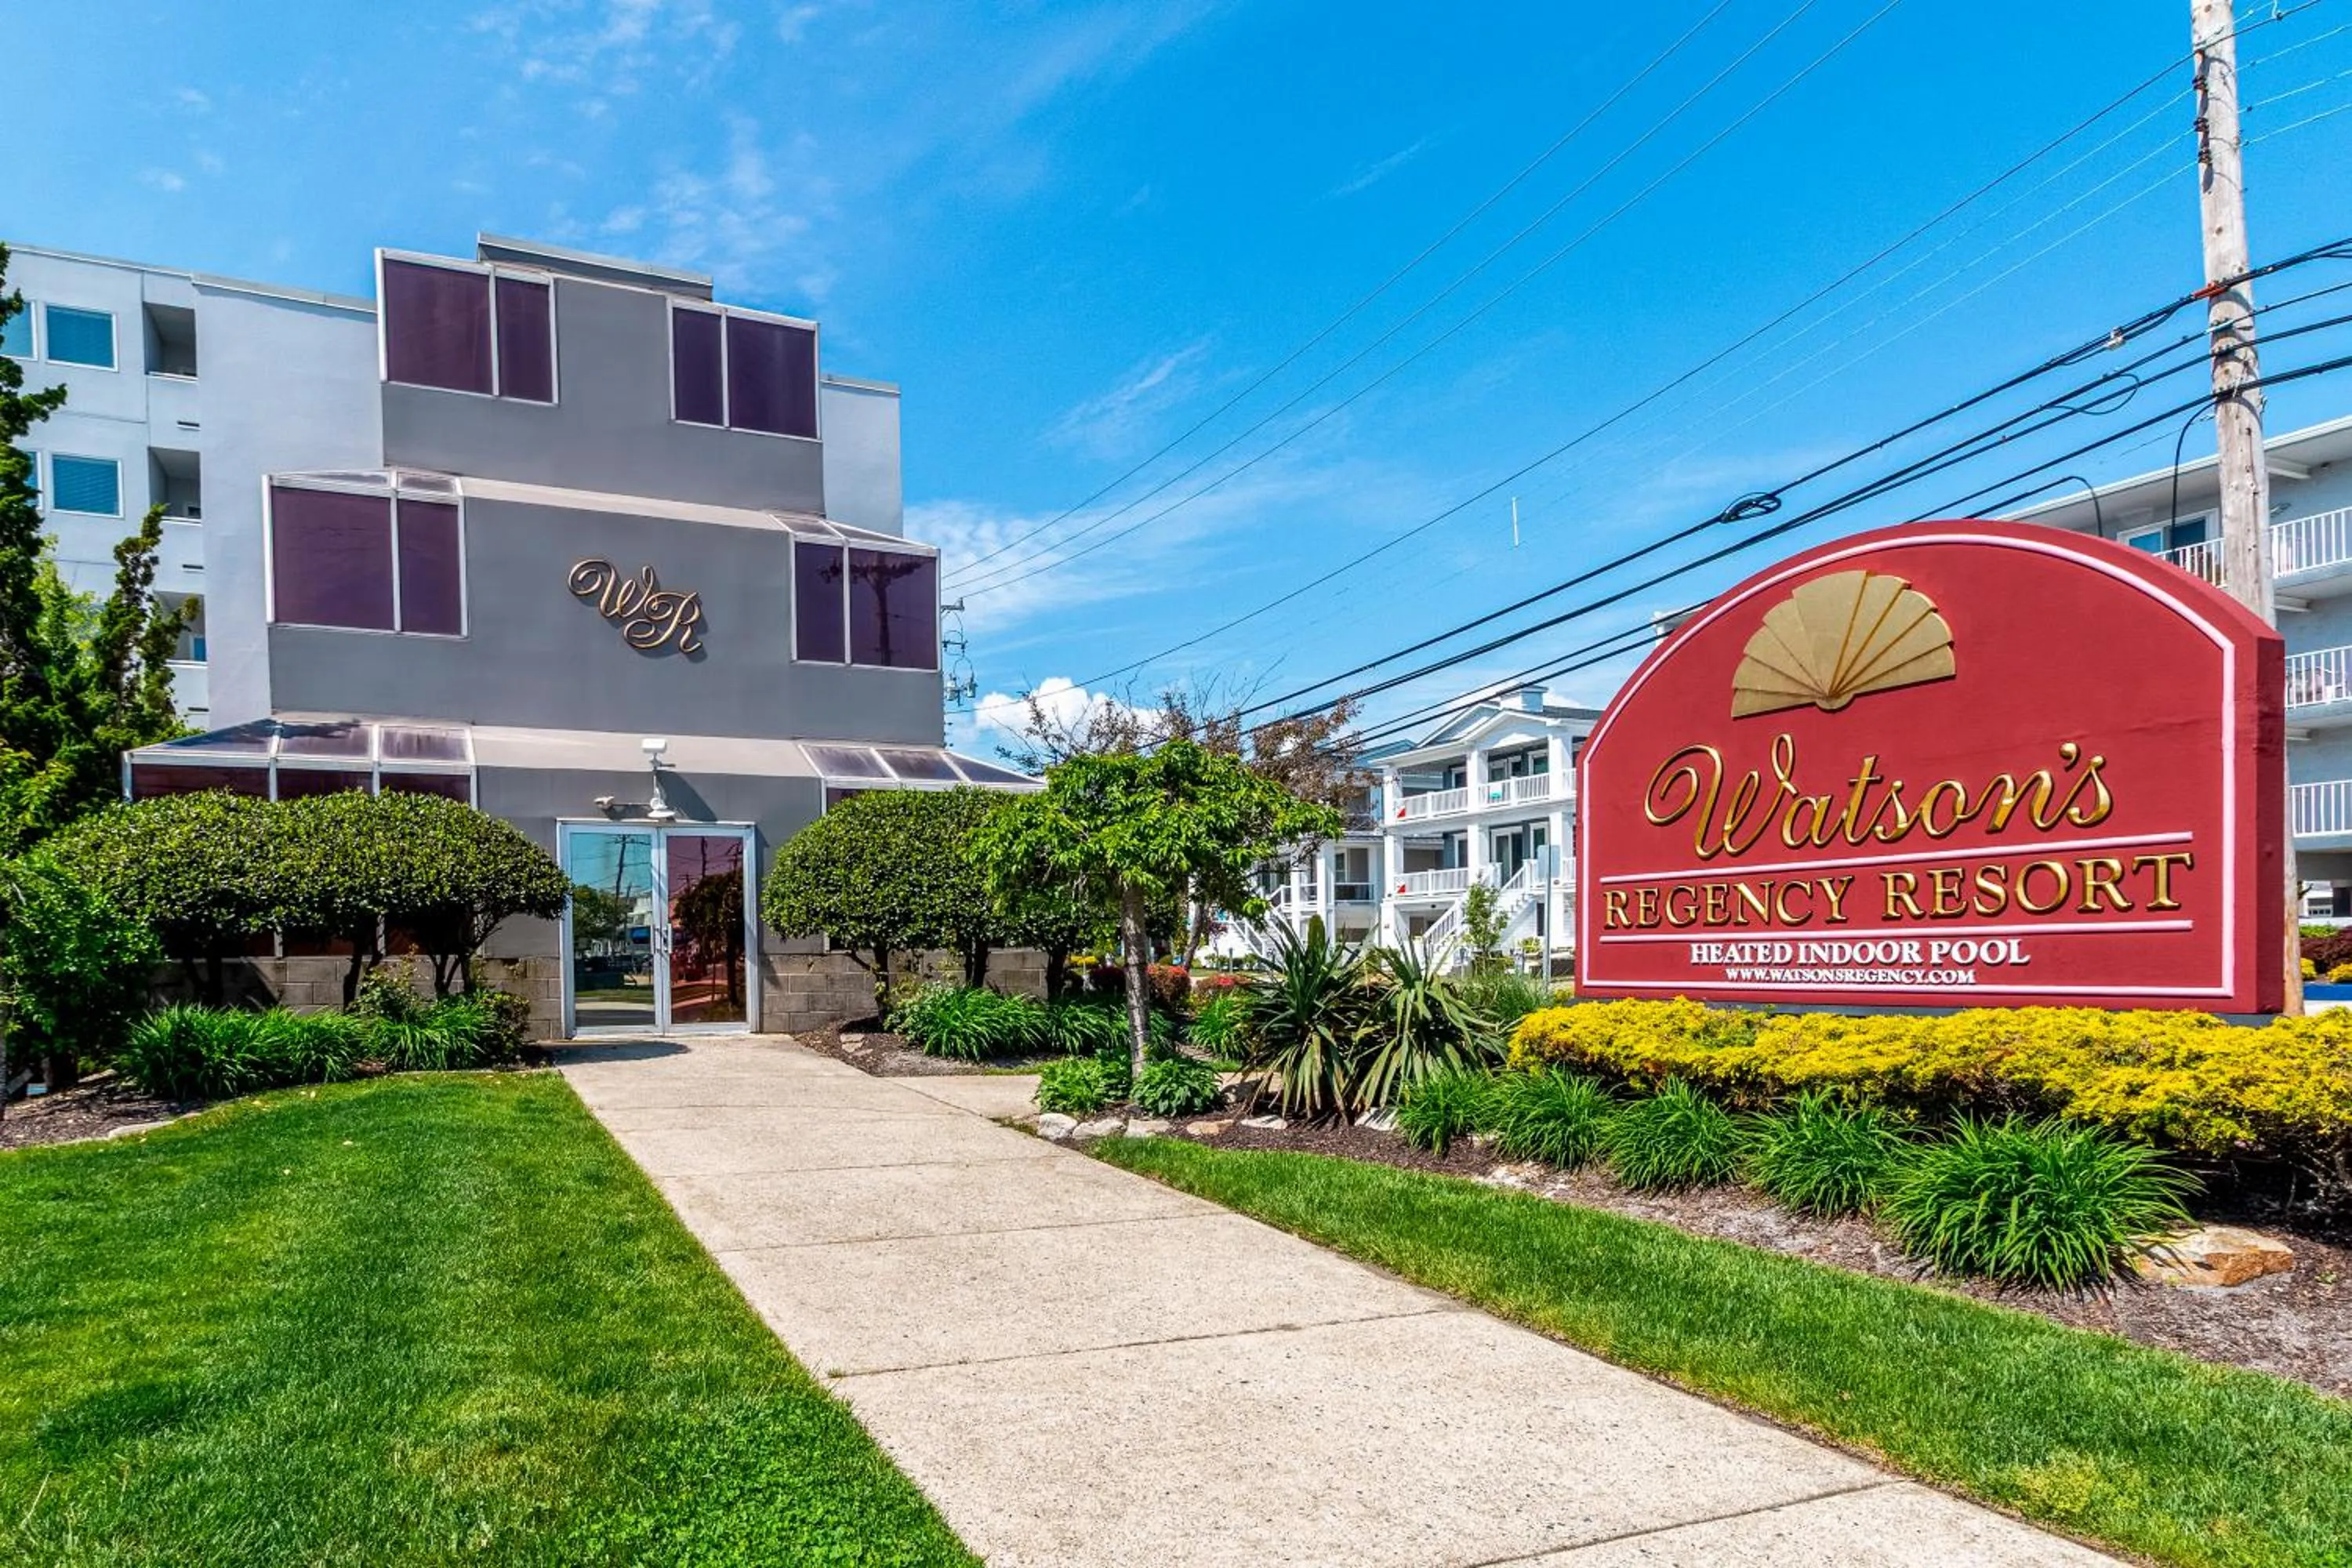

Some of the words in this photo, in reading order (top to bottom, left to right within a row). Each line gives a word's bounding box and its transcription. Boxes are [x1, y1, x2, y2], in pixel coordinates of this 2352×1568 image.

[1645, 733, 2113, 859] Watson's
[1603, 875, 1855, 928] REGENCY
[1880, 852, 2194, 920] RESORT
[1690, 942, 1793, 965] HEATED
[1797, 940, 1924, 965] INDOOR
[1928, 938, 2032, 965] POOL
[1726, 968, 1976, 984] WWW.WATSONSREGENCY.COM
